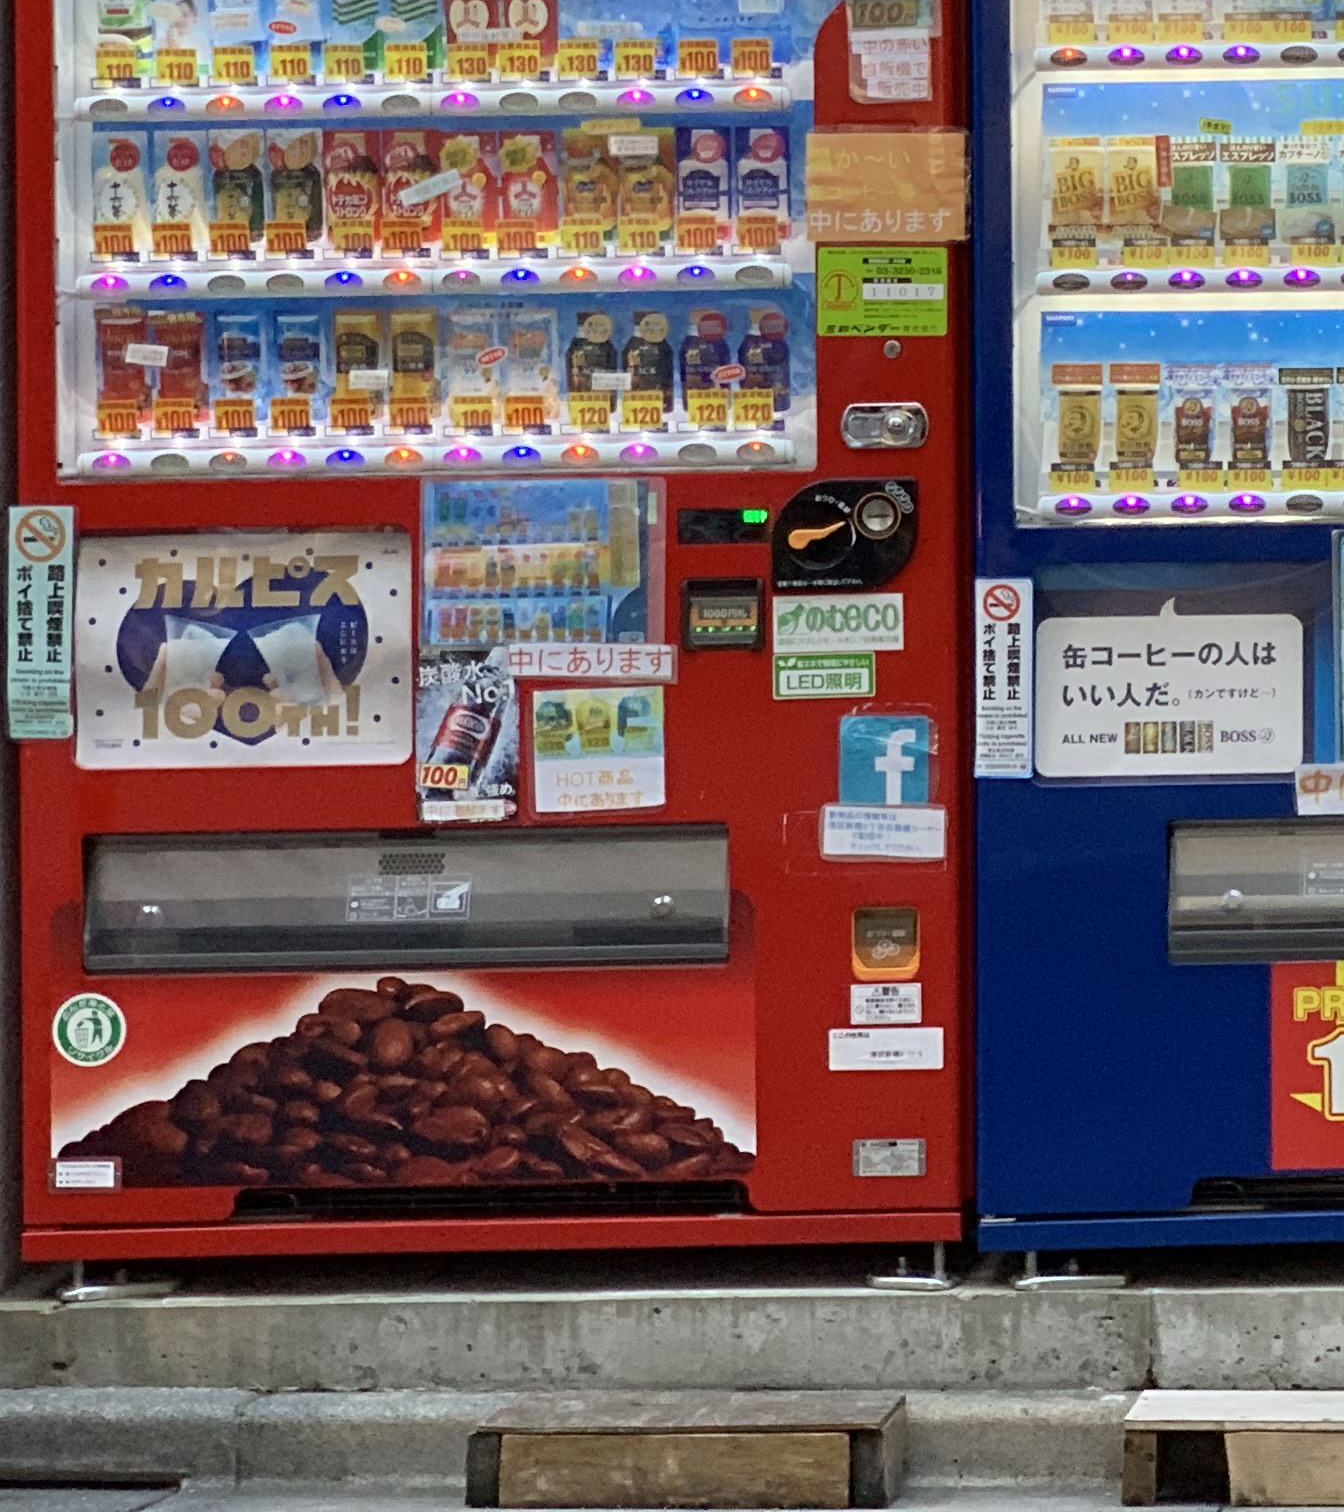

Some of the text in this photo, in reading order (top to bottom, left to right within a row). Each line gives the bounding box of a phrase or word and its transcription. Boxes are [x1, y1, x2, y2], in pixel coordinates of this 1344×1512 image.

[809, 208, 954, 234] 中にあります
[133, 554, 361, 610] カルピス
[16, 564, 34, 664] ポイ捨て禁止
[45, 564, 65, 664] 路上喫煙禁止
[508, 647, 673, 675] 中にあります
[1061, 642, 1277, 670] 缶コーヒーの人は
[418, 661, 484, 687] 炭酸水
[786, 672, 862, 691] LED照明
[1061, 684, 1182, 708] いい人だ。
[1061, 728, 1258, 745] ALL NEW BOSS
